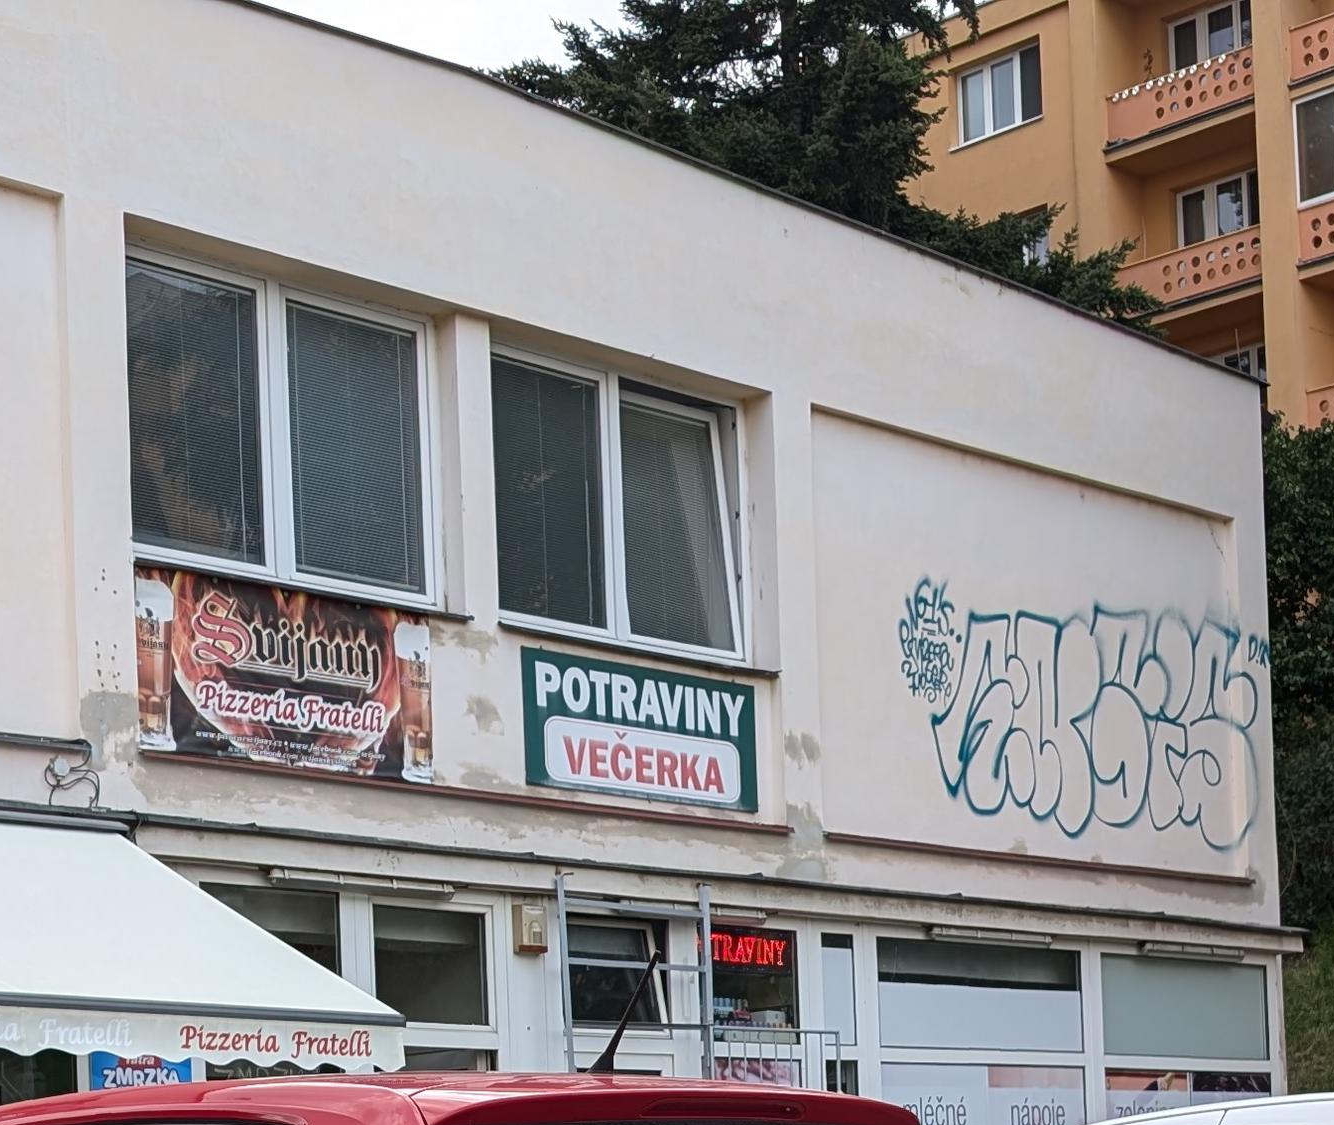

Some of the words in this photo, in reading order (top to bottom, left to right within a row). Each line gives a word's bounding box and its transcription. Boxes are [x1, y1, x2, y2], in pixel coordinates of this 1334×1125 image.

[192, 592, 381, 693] Svijany
[197, 682, 298, 723] Pizzeria
[301, 698, 385, 734] Fratelli
[536, 661, 745, 737] POTRAVINY
[563, 731, 725, 794] VEČERKA
[710, 933, 787, 967] TRAVINY
[38, 1017, 132, 1048] Fratelli
[180, 1024, 280, 1054] Pizzeria
[291, 1029, 373, 1059] Fratelli
[102, 1067, 180, 1089] ZMRZKA
